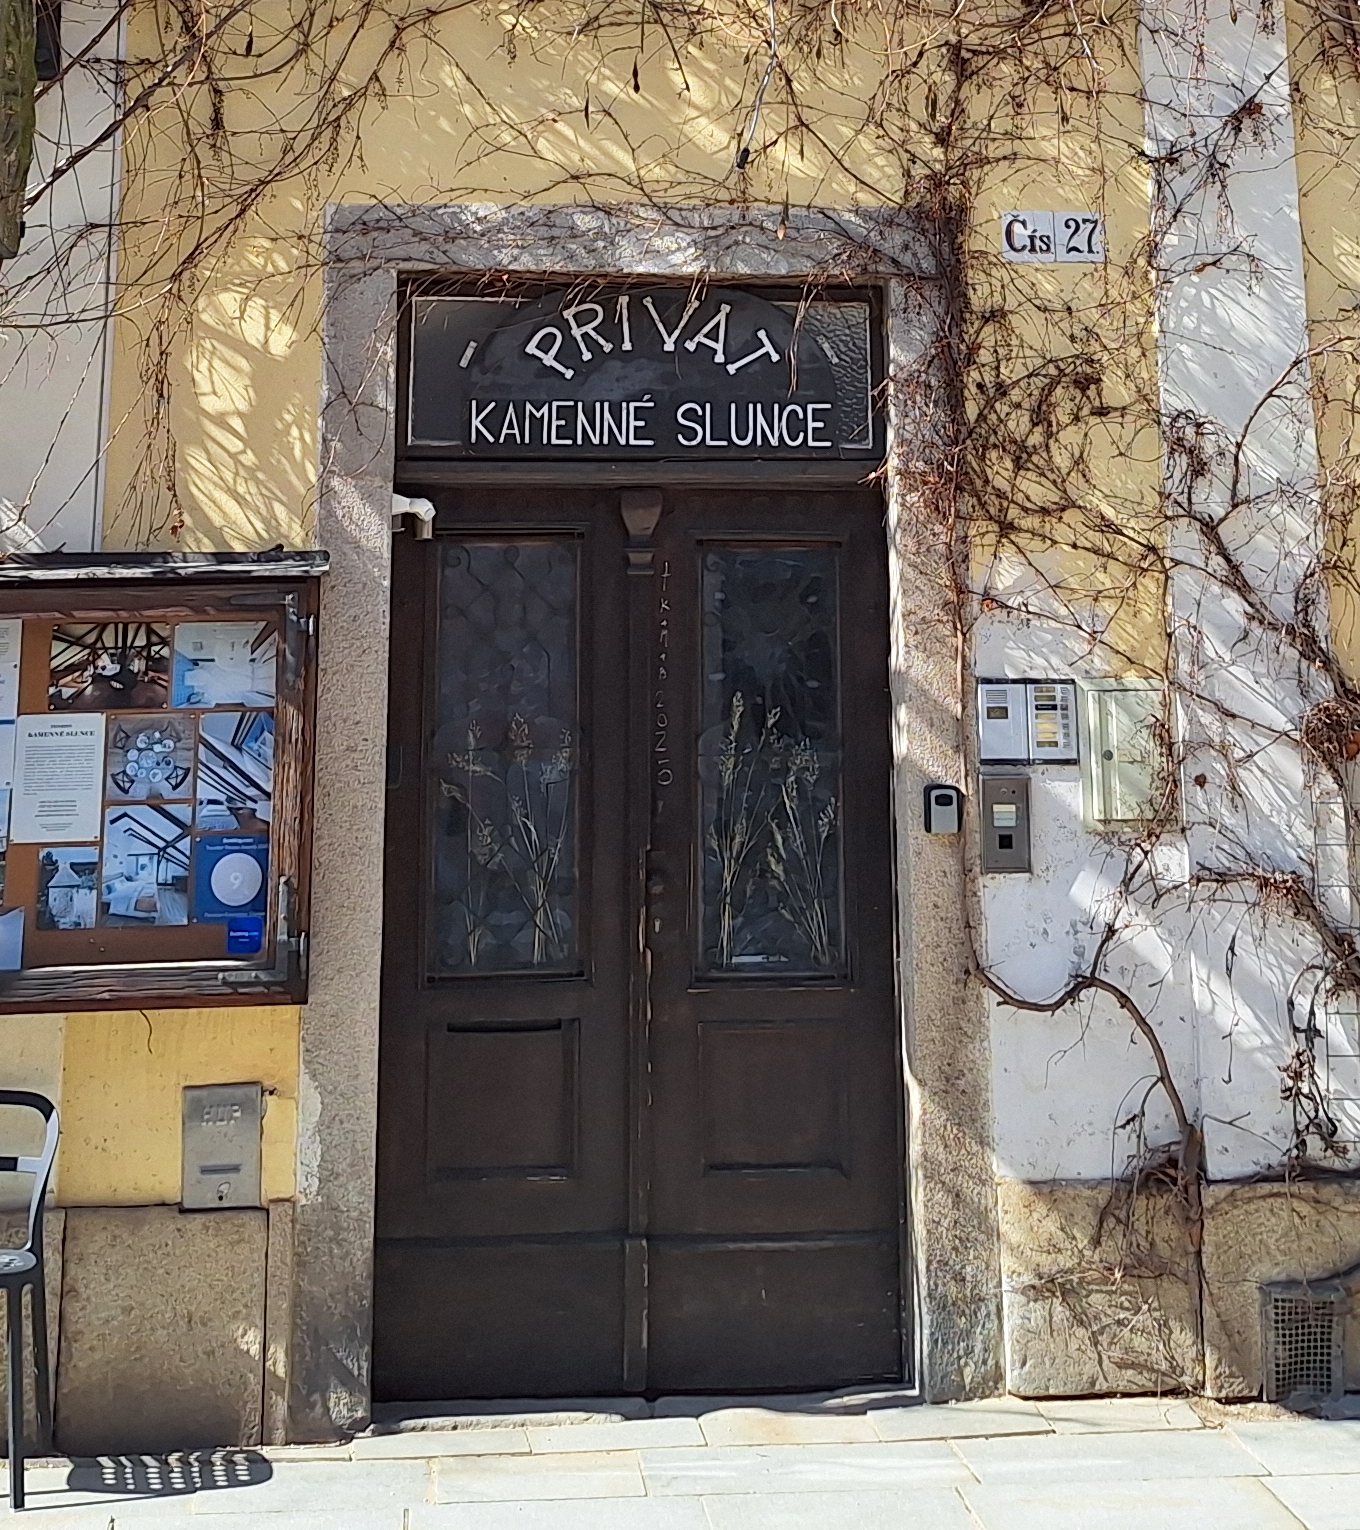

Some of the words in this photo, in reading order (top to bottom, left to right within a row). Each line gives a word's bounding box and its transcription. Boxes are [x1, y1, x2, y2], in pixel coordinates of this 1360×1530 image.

[525, 295, 782, 381] PRIVAT
[468, 394, 656, 447] KAMENNÉ
[677, 401, 833, 448] SLUNCE
